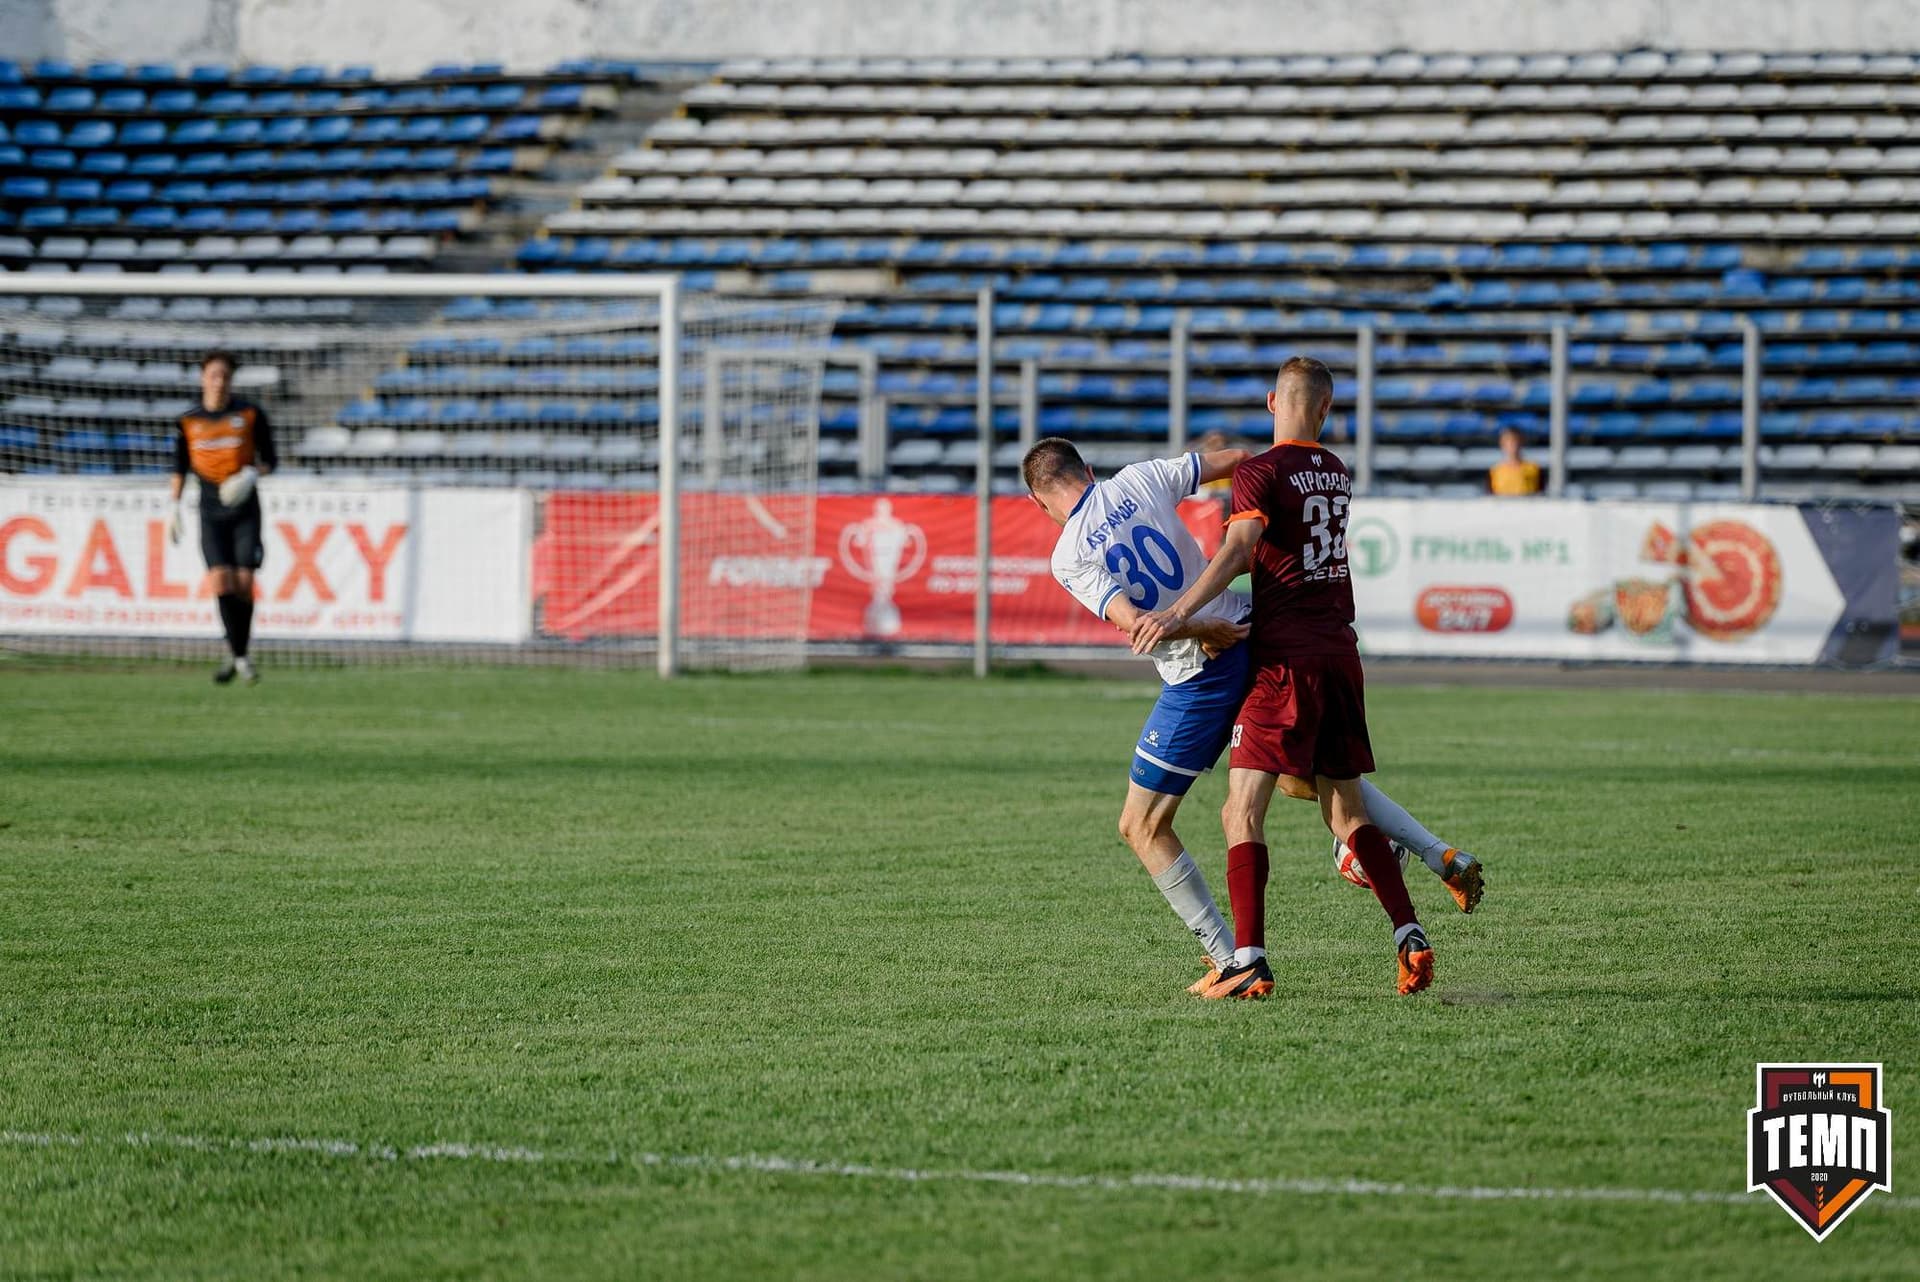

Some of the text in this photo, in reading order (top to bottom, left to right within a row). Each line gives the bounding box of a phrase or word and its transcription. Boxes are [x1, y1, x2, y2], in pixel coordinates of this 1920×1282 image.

[1105, 525, 1184, 611] 30
[1302, 495, 1350, 570] 33
[1411, 537, 1513, 562] ГРИЛЬ
